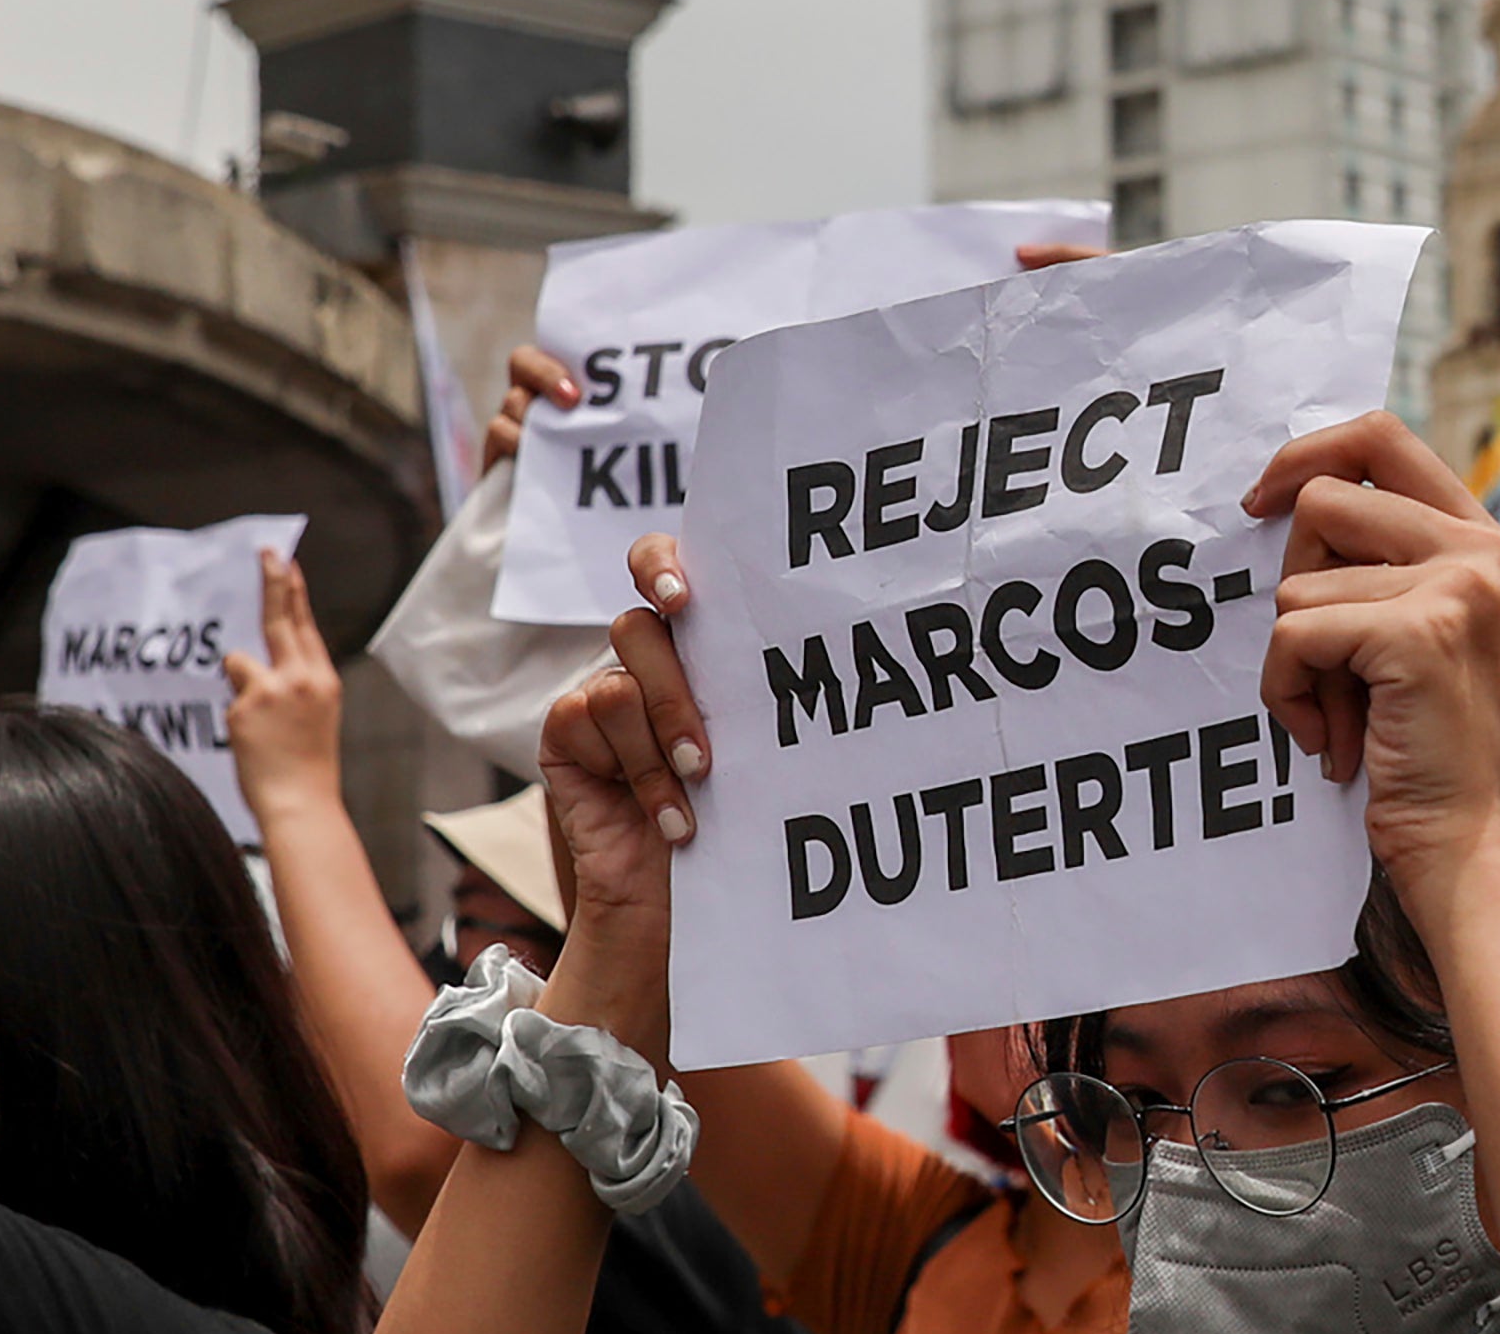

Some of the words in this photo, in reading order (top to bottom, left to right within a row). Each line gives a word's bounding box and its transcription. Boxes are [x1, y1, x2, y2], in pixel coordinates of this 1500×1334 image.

[786, 369, 1225, 569] REJECT
[762, 539, 1253, 748] MARCOS-
[784, 714, 1295, 920] DUTERTE!
